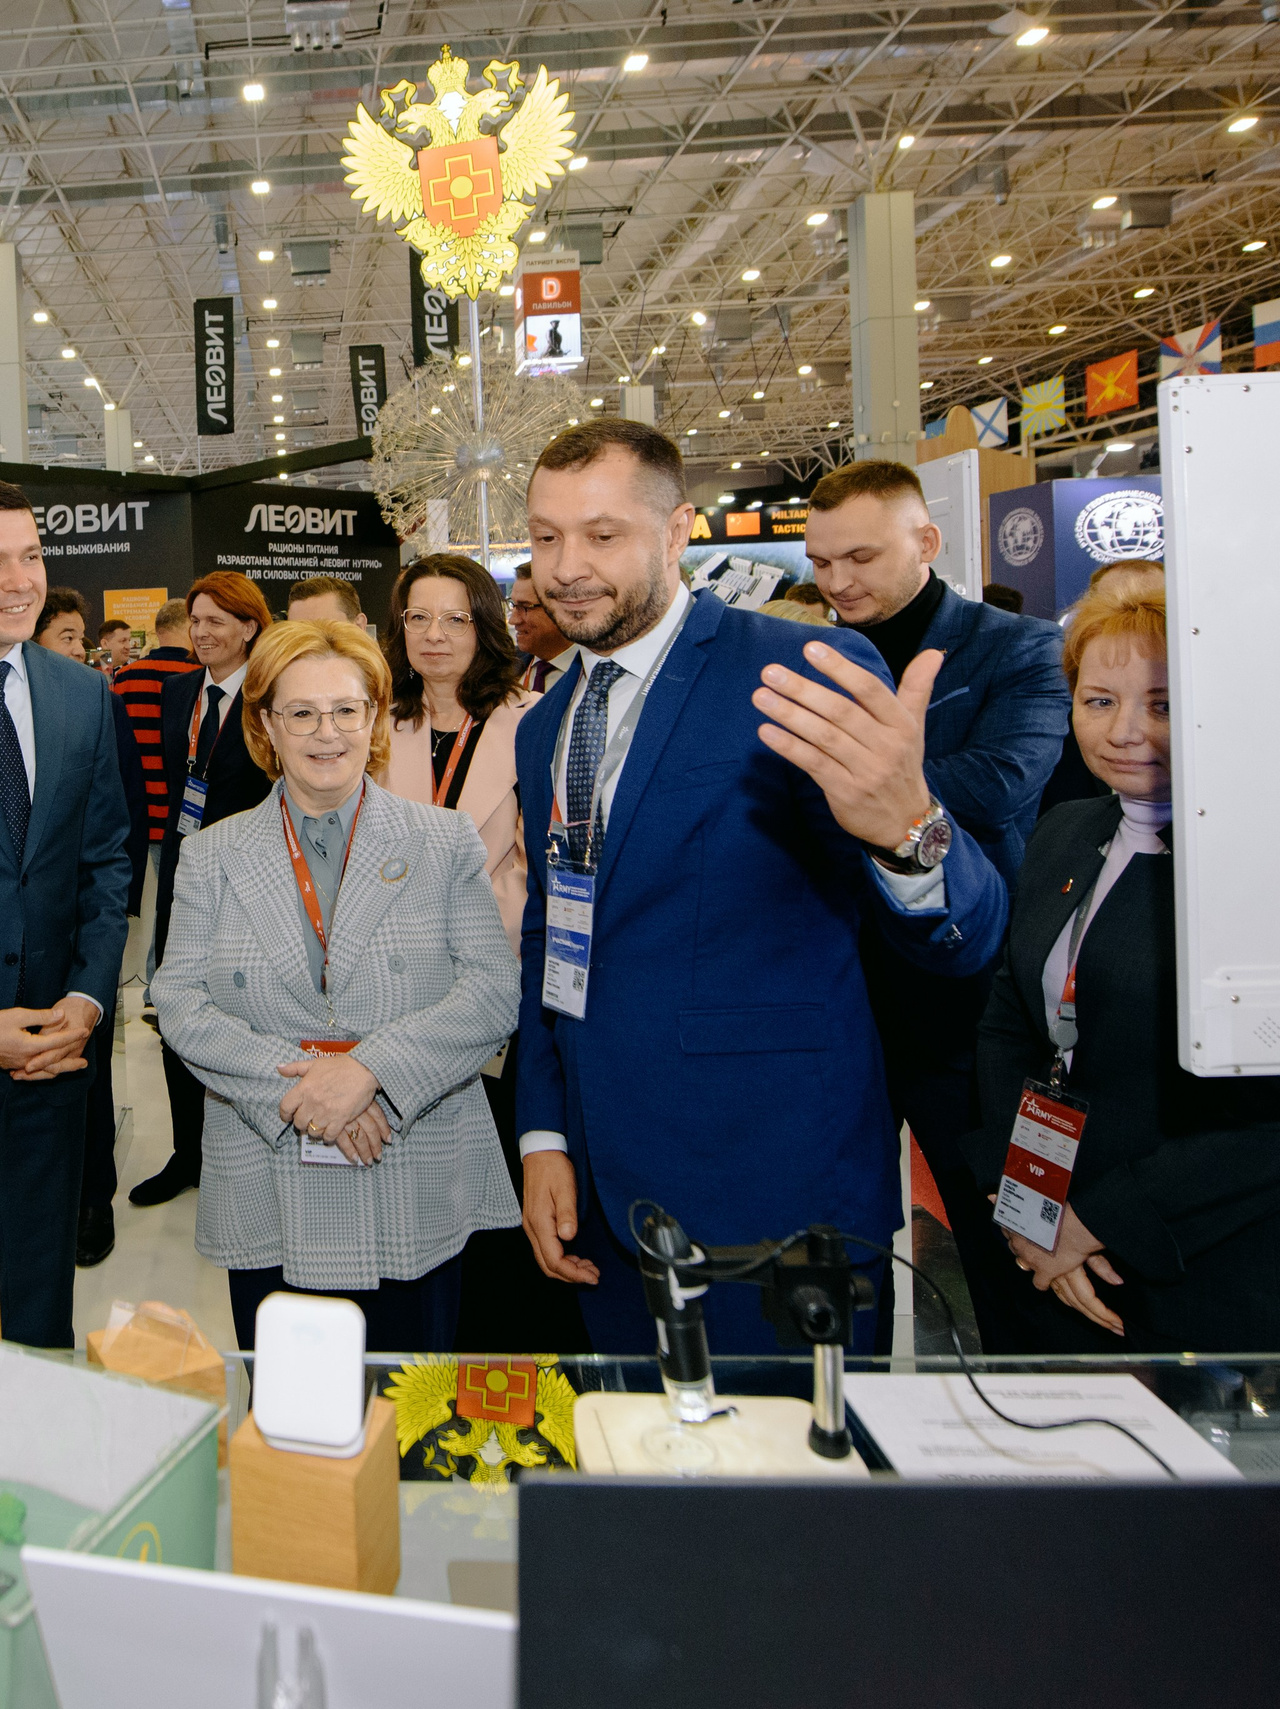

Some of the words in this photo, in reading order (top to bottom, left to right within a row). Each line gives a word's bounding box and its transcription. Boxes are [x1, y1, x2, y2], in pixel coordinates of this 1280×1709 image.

[525, 258, 554, 267] ПАТРИОТ
[555, 257, 576, 266] ЭКСПО
[541, 277, 561, 300] D
[532, 301, 572, 311] ПАВИЛЬОН
[204, 309, 228, 425] ЛЕОВИТ
[358, 355, 379, 437] ЕОВИТ
[31, 501, 150, 535] ЕОВИТ
[244, 503, 358, 536] ЛЕОВИТ
[771, 523, 806, 535] TACTIC
[42, 545, 64, 557] ОНЫ
[66, 542, 130, 555] ВЫЖИВАНИЯ
[268, 542, 305, 554] РАЦИОНЫ
[306, 543, 339, 554] ПИТАНИЯ
[217, 554, 271, 566] РАЗРАБОТАНЫ
[273, 556, 318, 567] КОМПАНИЕЙ
[320, 558, 350, 568] «ЛЕОВИТ
[245, 569, 261, 580] ДЛЯ
[263, 569, 299, 580] СИЛОВЫХ
[335, 571, 362, 581] РОССИИ
[1029, 1163, 1045, 1177] VIP
